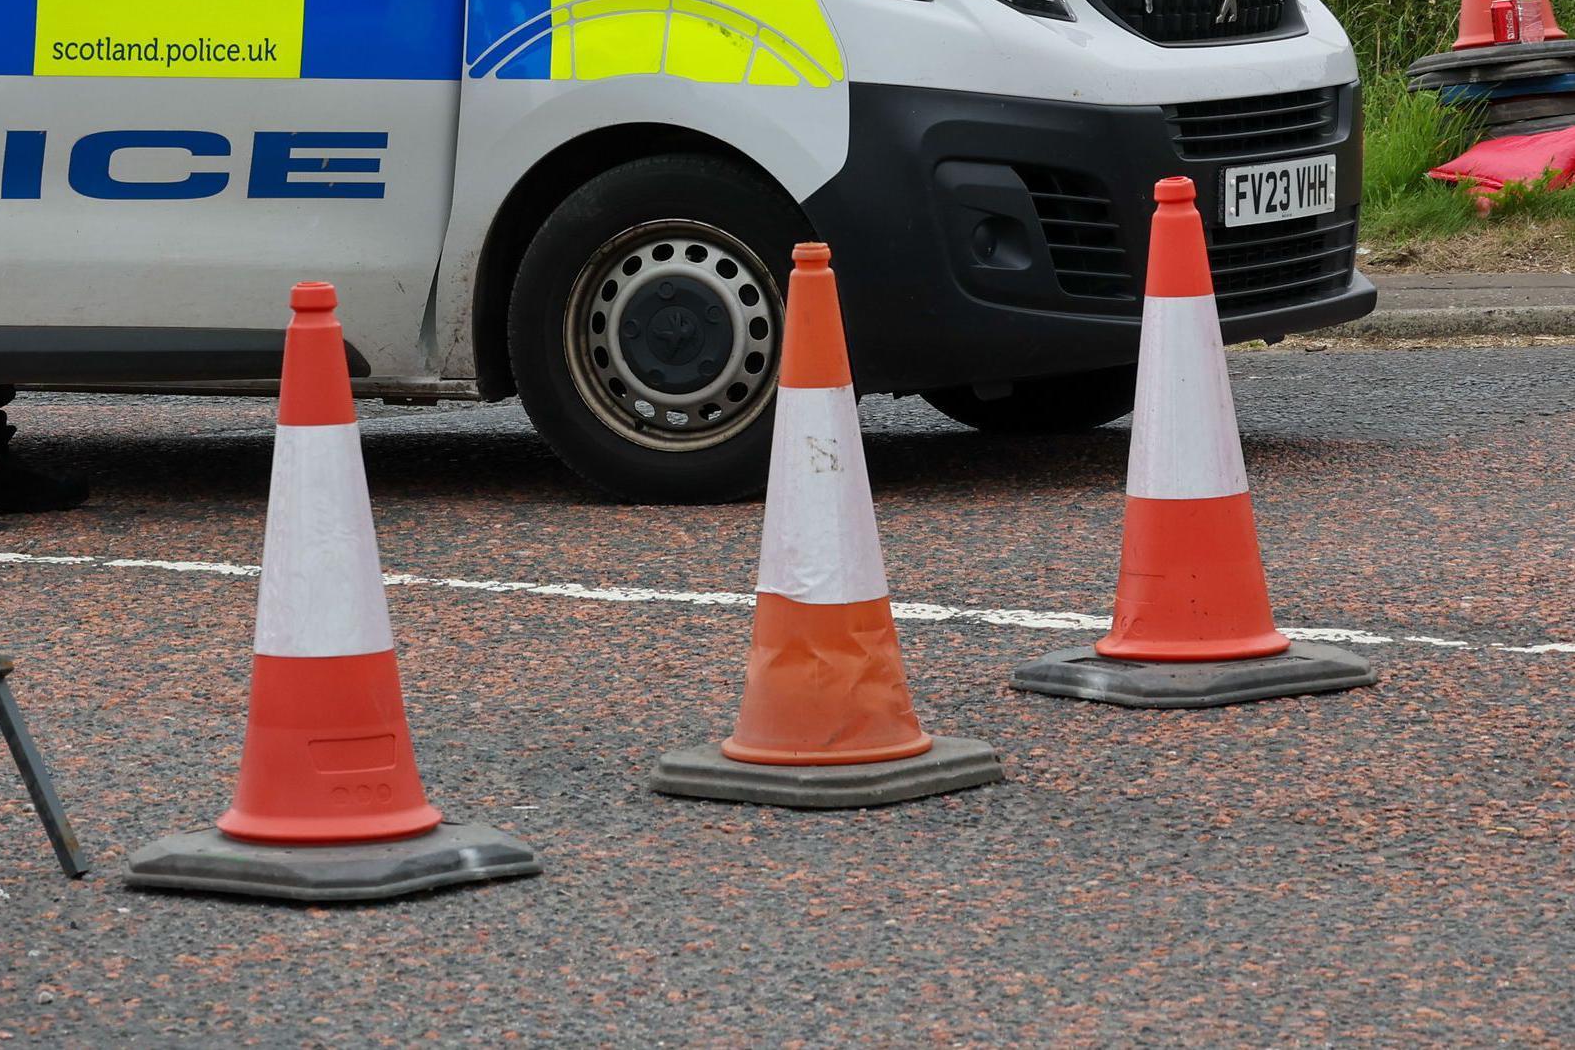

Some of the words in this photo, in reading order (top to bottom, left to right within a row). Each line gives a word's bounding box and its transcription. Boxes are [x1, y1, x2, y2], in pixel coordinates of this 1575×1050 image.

[52, 36, 277, 69] scotland.police.uk
[1235, 169, 1291, 217] FV23
[1296, 163, 1328, 208] VHH
